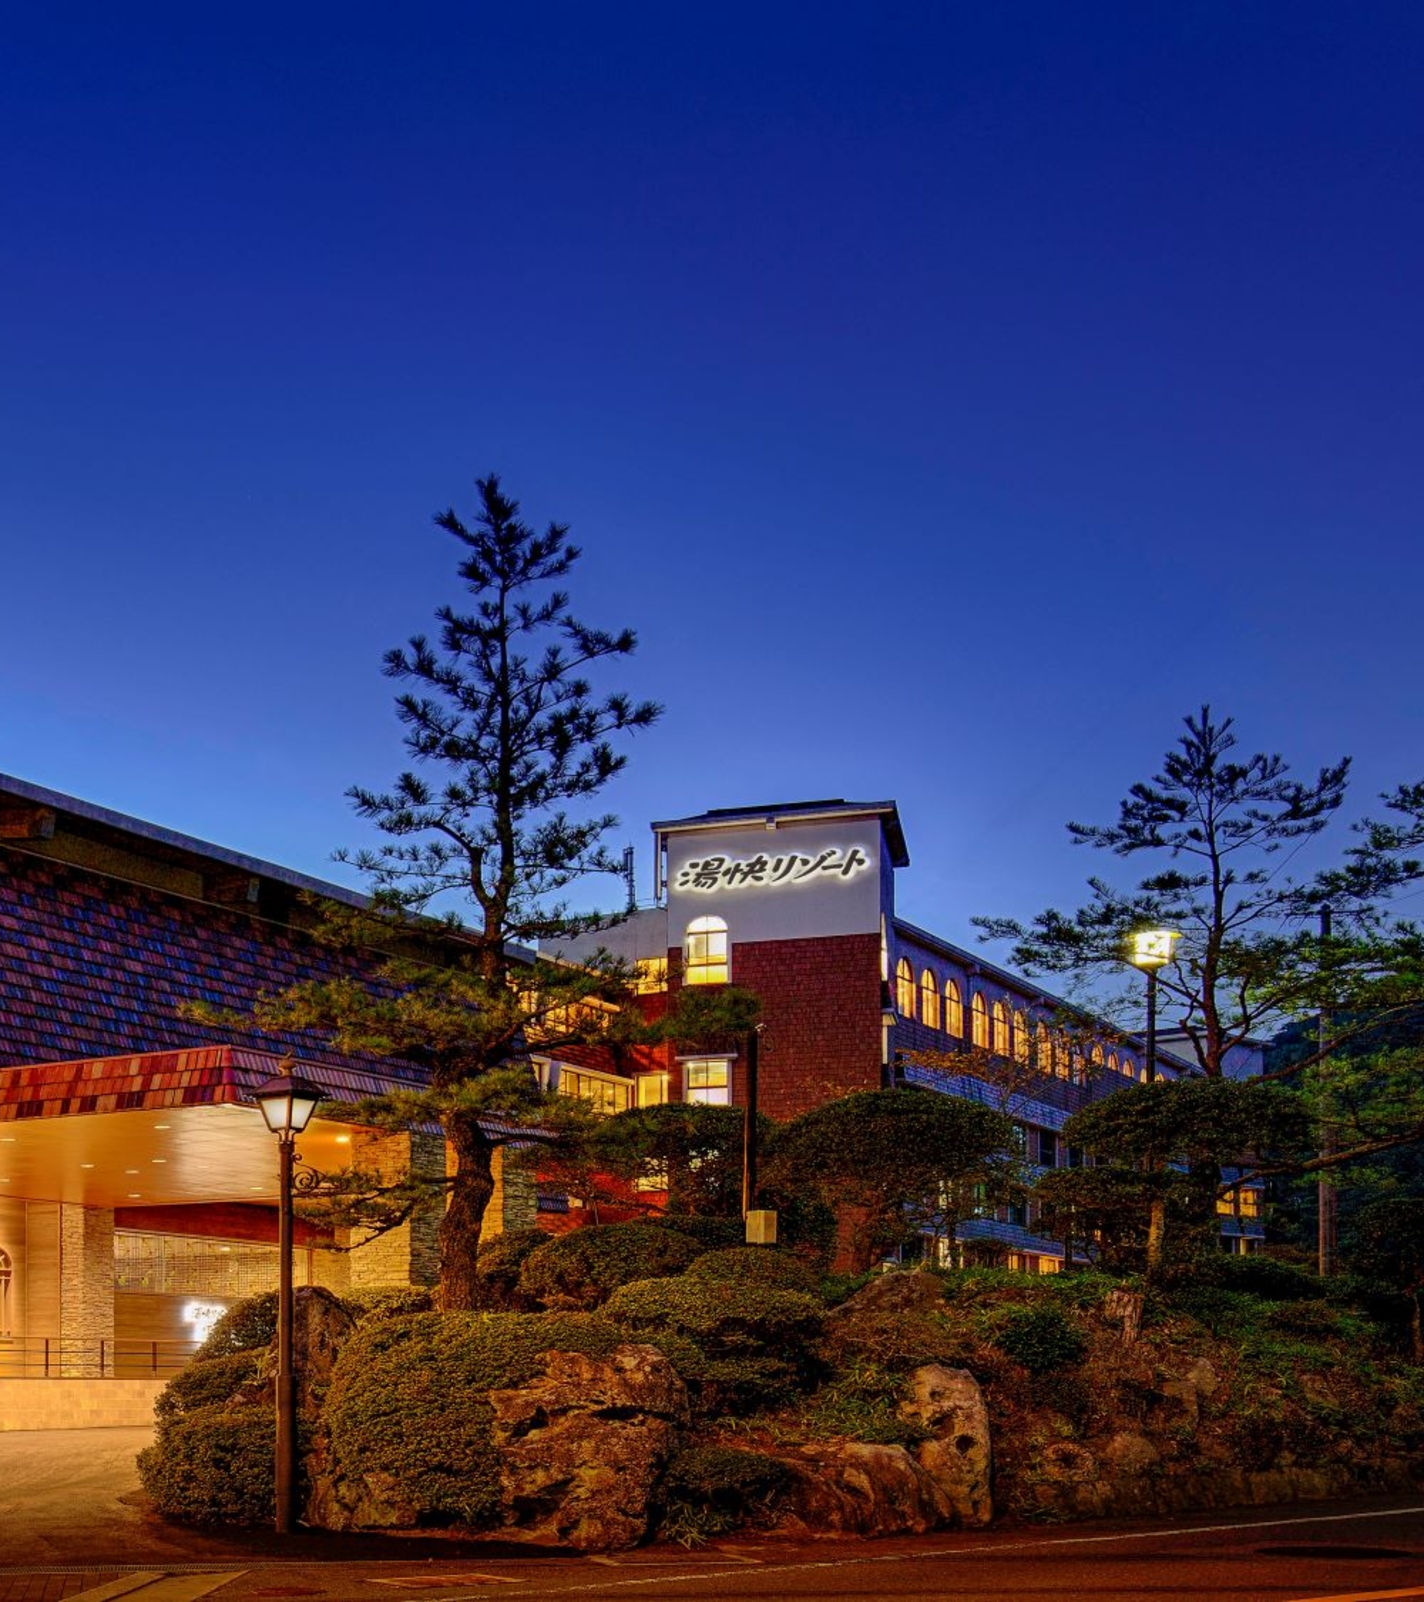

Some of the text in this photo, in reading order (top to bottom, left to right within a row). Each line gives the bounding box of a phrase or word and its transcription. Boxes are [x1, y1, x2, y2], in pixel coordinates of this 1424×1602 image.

[678, 849, 866, 889] 湯快リゾート
